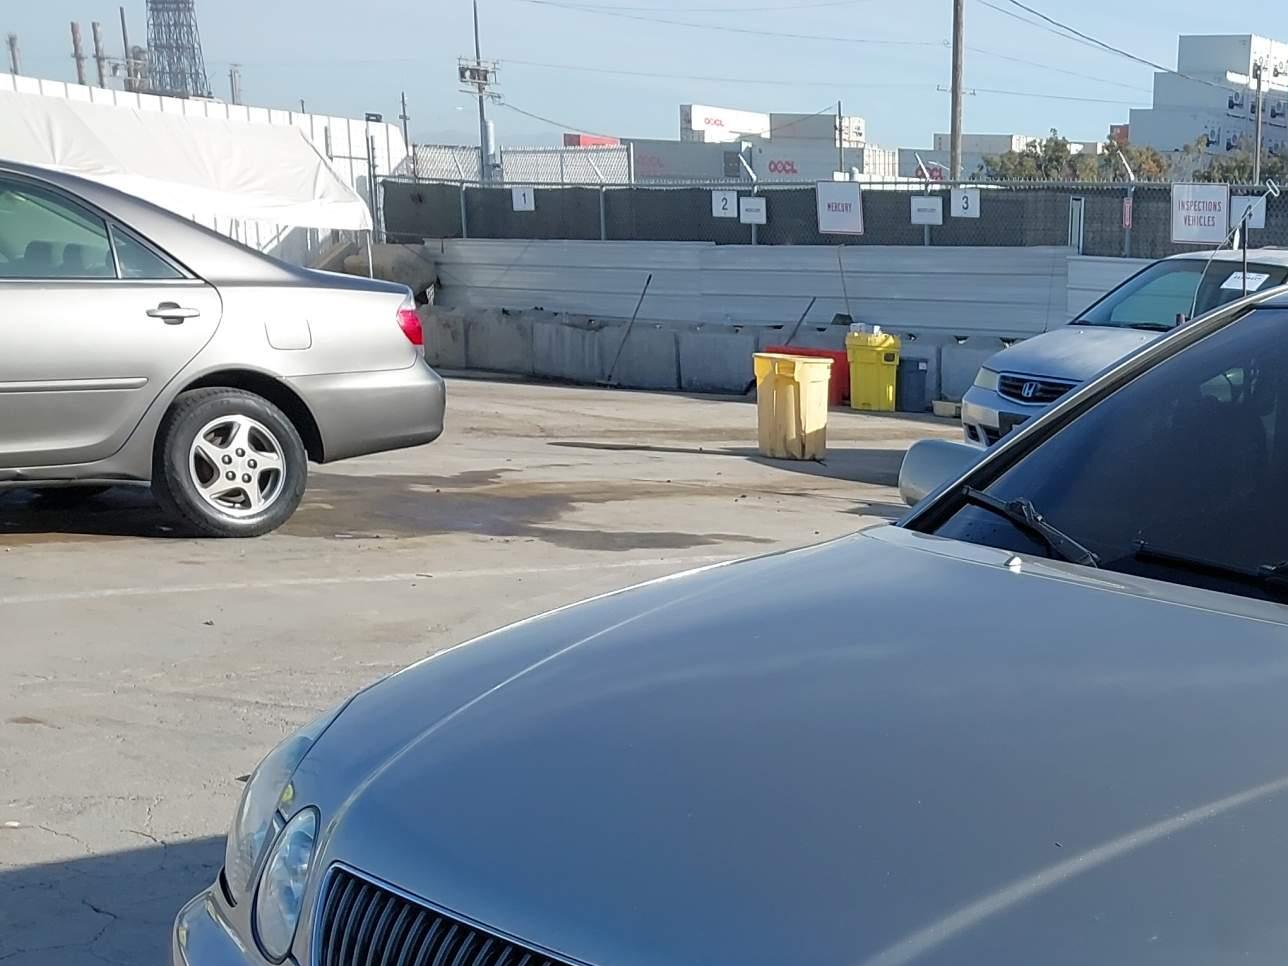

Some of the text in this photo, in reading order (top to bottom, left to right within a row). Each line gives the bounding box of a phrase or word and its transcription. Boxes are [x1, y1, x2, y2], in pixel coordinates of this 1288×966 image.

[768, 160, 798, 175] OOCL
[521, 192, 527, 205] 1
[721, 197, 729, 211] 2
[962, 195, 969, 210] 3
[1178, 200, 1222, 212] INSPECTIONS
[1183, 214, 1216, 227] VEHICLES
